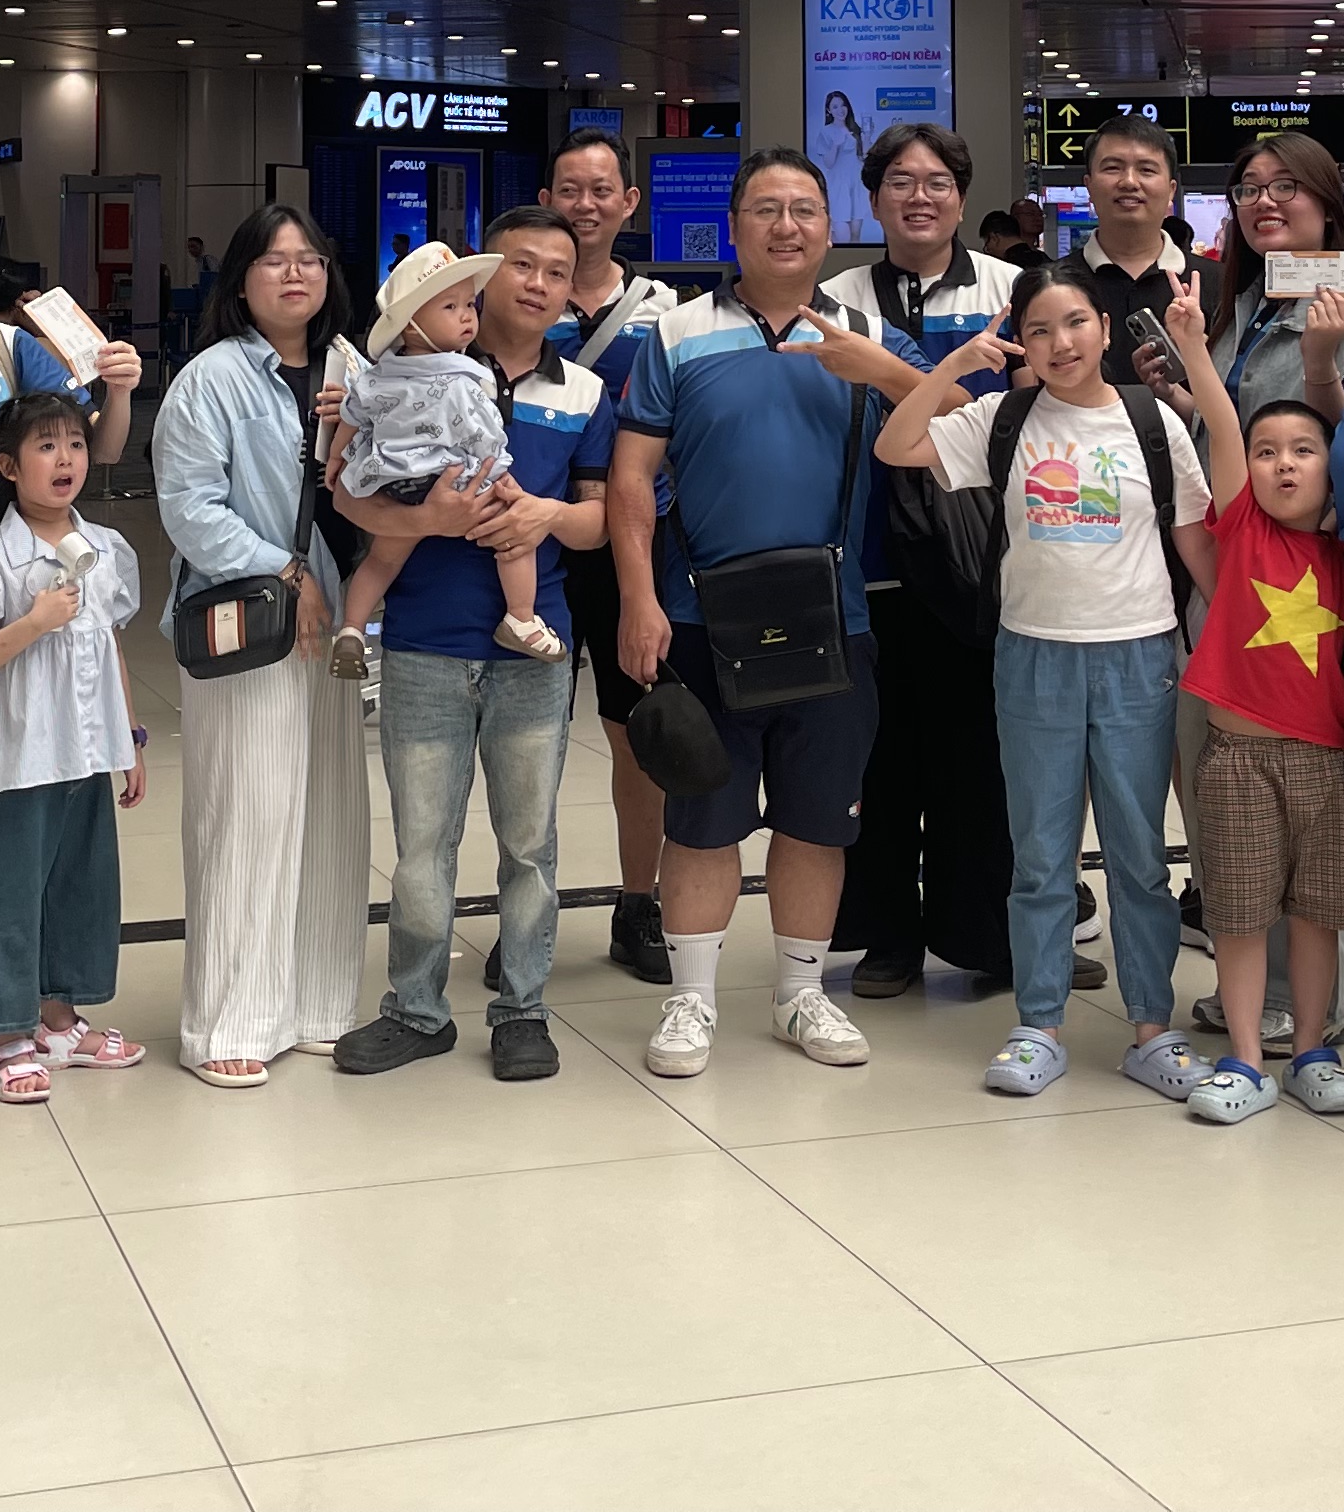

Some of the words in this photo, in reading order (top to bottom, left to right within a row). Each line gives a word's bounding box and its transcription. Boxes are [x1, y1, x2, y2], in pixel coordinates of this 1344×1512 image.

[839, 51, 846, 62] 3
[849, 50, 911, 62] HYDRO-ION
[355, 91, 436, 128] ACV
[1256, 104, 1268, 112] ra
[1270, 101, 1288, 112] tàu
[1290, 101, 1311, 113] bay
[1117, 104, 1158, 123] 79
[1233, 116, 1279, 128] Boarding
[1280, 116, 1310, 128] gates
